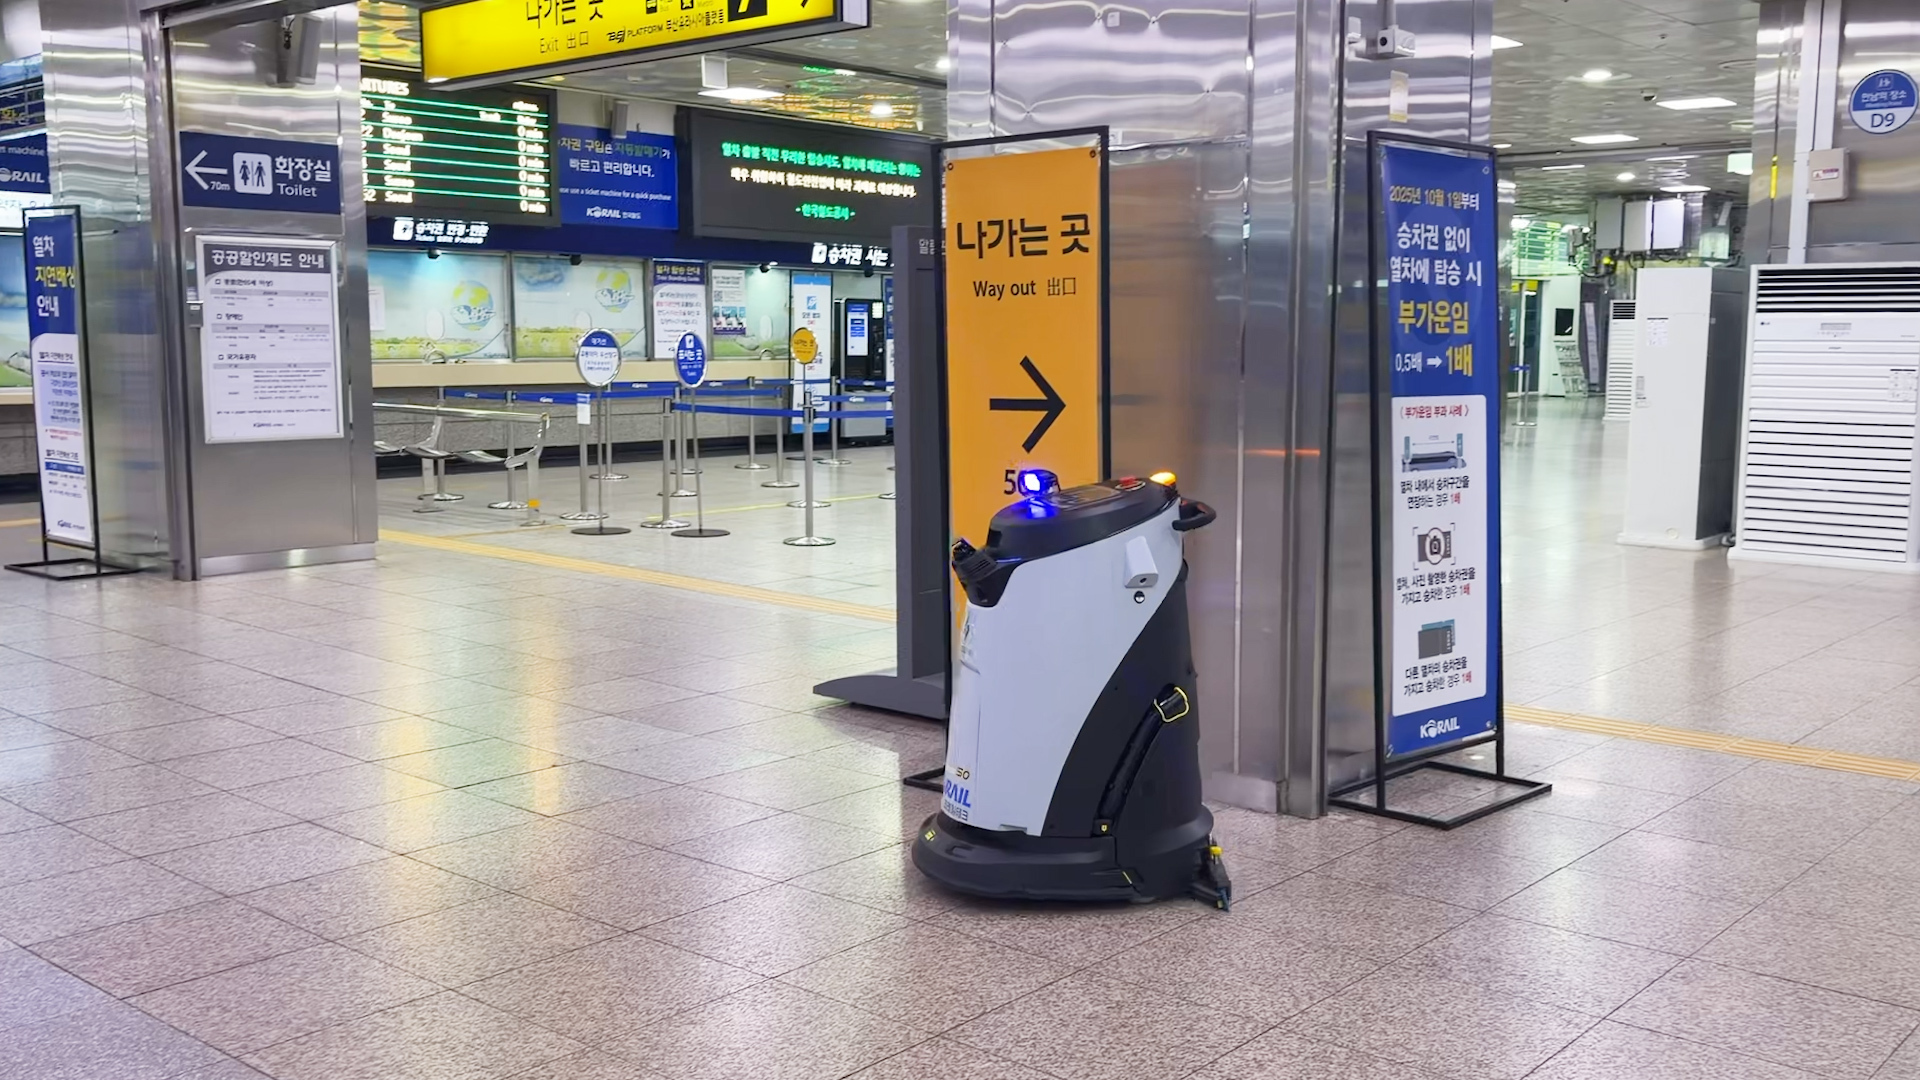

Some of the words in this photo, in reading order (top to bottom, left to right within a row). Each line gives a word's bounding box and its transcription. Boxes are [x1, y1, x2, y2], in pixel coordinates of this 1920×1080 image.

[567, 30, 589, 49] 出口
[627, 24, 664, 38] PLATFORM
[540, 37, 558, 54] Exit
[1861, 91, 1889, 103] 만남의
[1889, 89, 1908, 101] 장소
[1871, 112, 1896, 128] D9
[8, 146, 45, 156] machine
[558, 137, 581, 152] 차권
[585, 139, 613, 155] 구입은
[275, 155, 331, 183] 화장실
[569, 158, 601, 173] 바르고
[603, 161, 655, 178] 편리합니다.
[210, 182, 231, 191] 70m
[277, 183, 317, 198] Toilet
[1389, 185, 1421, 205] 2025년
[1424, 188, 1445, 208] 10월
[1447, 191, 1480, 211] 1일부터
[586, 205, 622, 219] KORAIL
[32, 235, 55, 258] 열차
[957, 217, 1049, 260] 나가는
[1060, 213, 1091, 255] 곳
[1397, 221, 1440, 250] 승차권
[1443, 225, 1470, 254] 없이
[211, 249, 293, 267] 공공할인제도
[298, 252, 325, 269] 안내
[1389, 255, 1430, 285] 열차에
[1434, 258, 1462, 287] 탑승
[1465, 260, 1482, 288] 시
[973, 280, 1006, 301] Way
[1010, 280, 1037, 297] out
[1047, 276, 1077, 297] 出口
[37, 295, 60, 318] 안내
[1398, 299, 1469, 335] 부가운임
[1395, 351, 1423, 374] 0.5배
[1445, 343, 1474, 378] 1배
[1436, 475, 1470, 491] 승차구간을
[1407, 494, 1433, 509] 연장하는
[1435, 492, 1449, 507] 경우
[1411, 573, 1426, 587] 사진
[1427, 570, 1447, 586] 촬영한
[1448, 566, 1476, 583] 승차권을
[1401, 590, 1422, 605] 가지고
[1445, 584, 1458, 599] 경우
[1405, 665, 1419, 680] 다른
[1421, 661, 1441, 678] 열차의
[1442, 655, 1468, 673] 승차권을
[1403, 681, 1425, 697] 가지고
[1447, 672, 1460, 688] 경우
[1462, 670, 1472, 684] 1배
[1419, 716, 1460, 739] KORAIL
